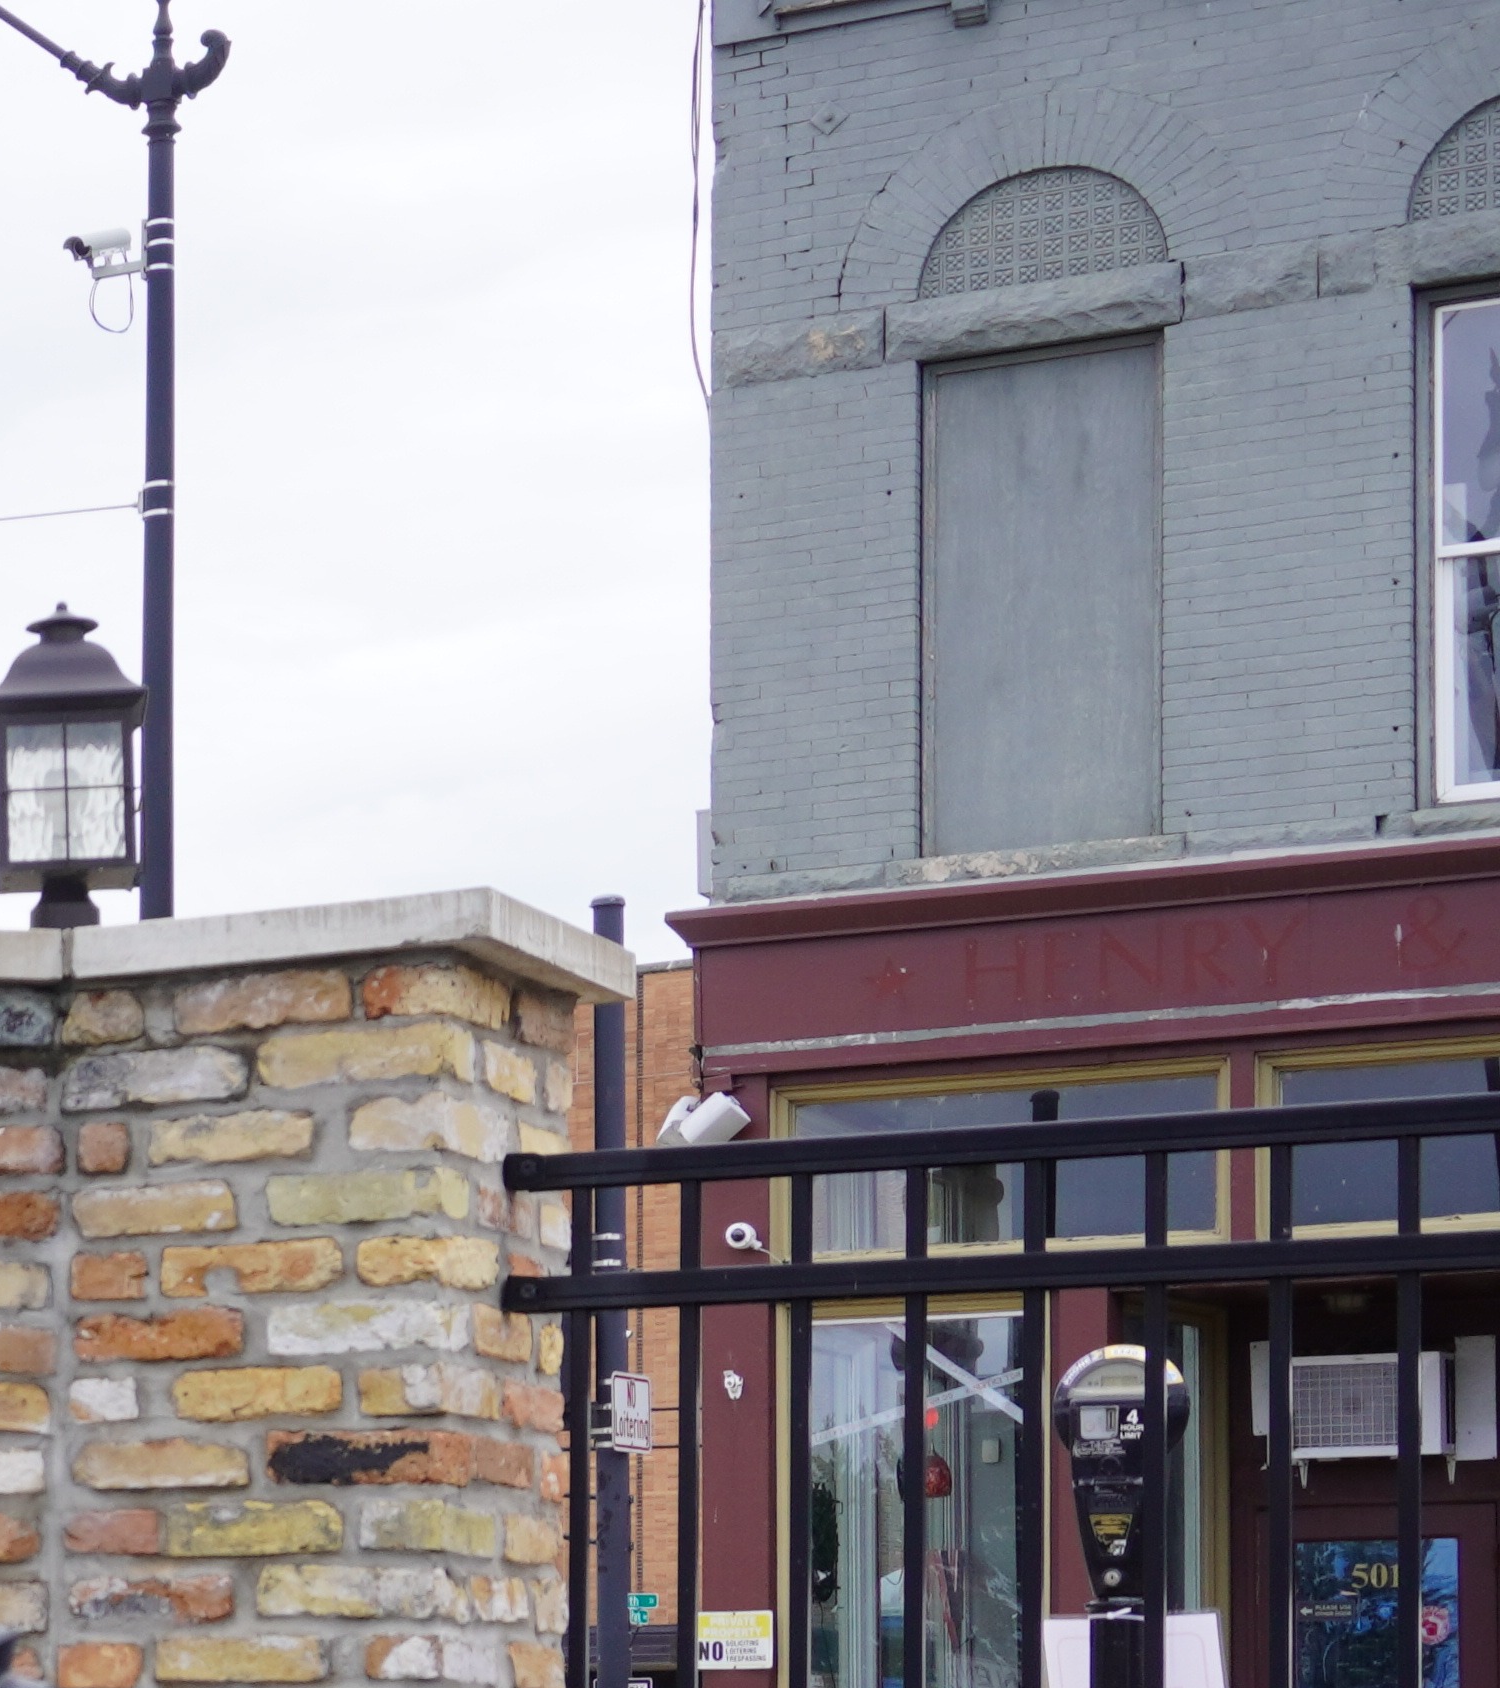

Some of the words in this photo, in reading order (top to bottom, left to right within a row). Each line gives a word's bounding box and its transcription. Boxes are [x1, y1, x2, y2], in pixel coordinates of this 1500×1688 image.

[965, 914, 1301, 996] HENRY
[627, 1380, 636, 1408] NO
[1120, 1423, 1144, 1432] HOUR
[1126, 1408, 1139, 1424] 4
[615, 1410, 649, 1447] Loitering
[1120, 1431, 1142, 1440] LIMIT
[1351, 1562, 1399, 1589] 501
[698, 1641, 723, 1661] NO
